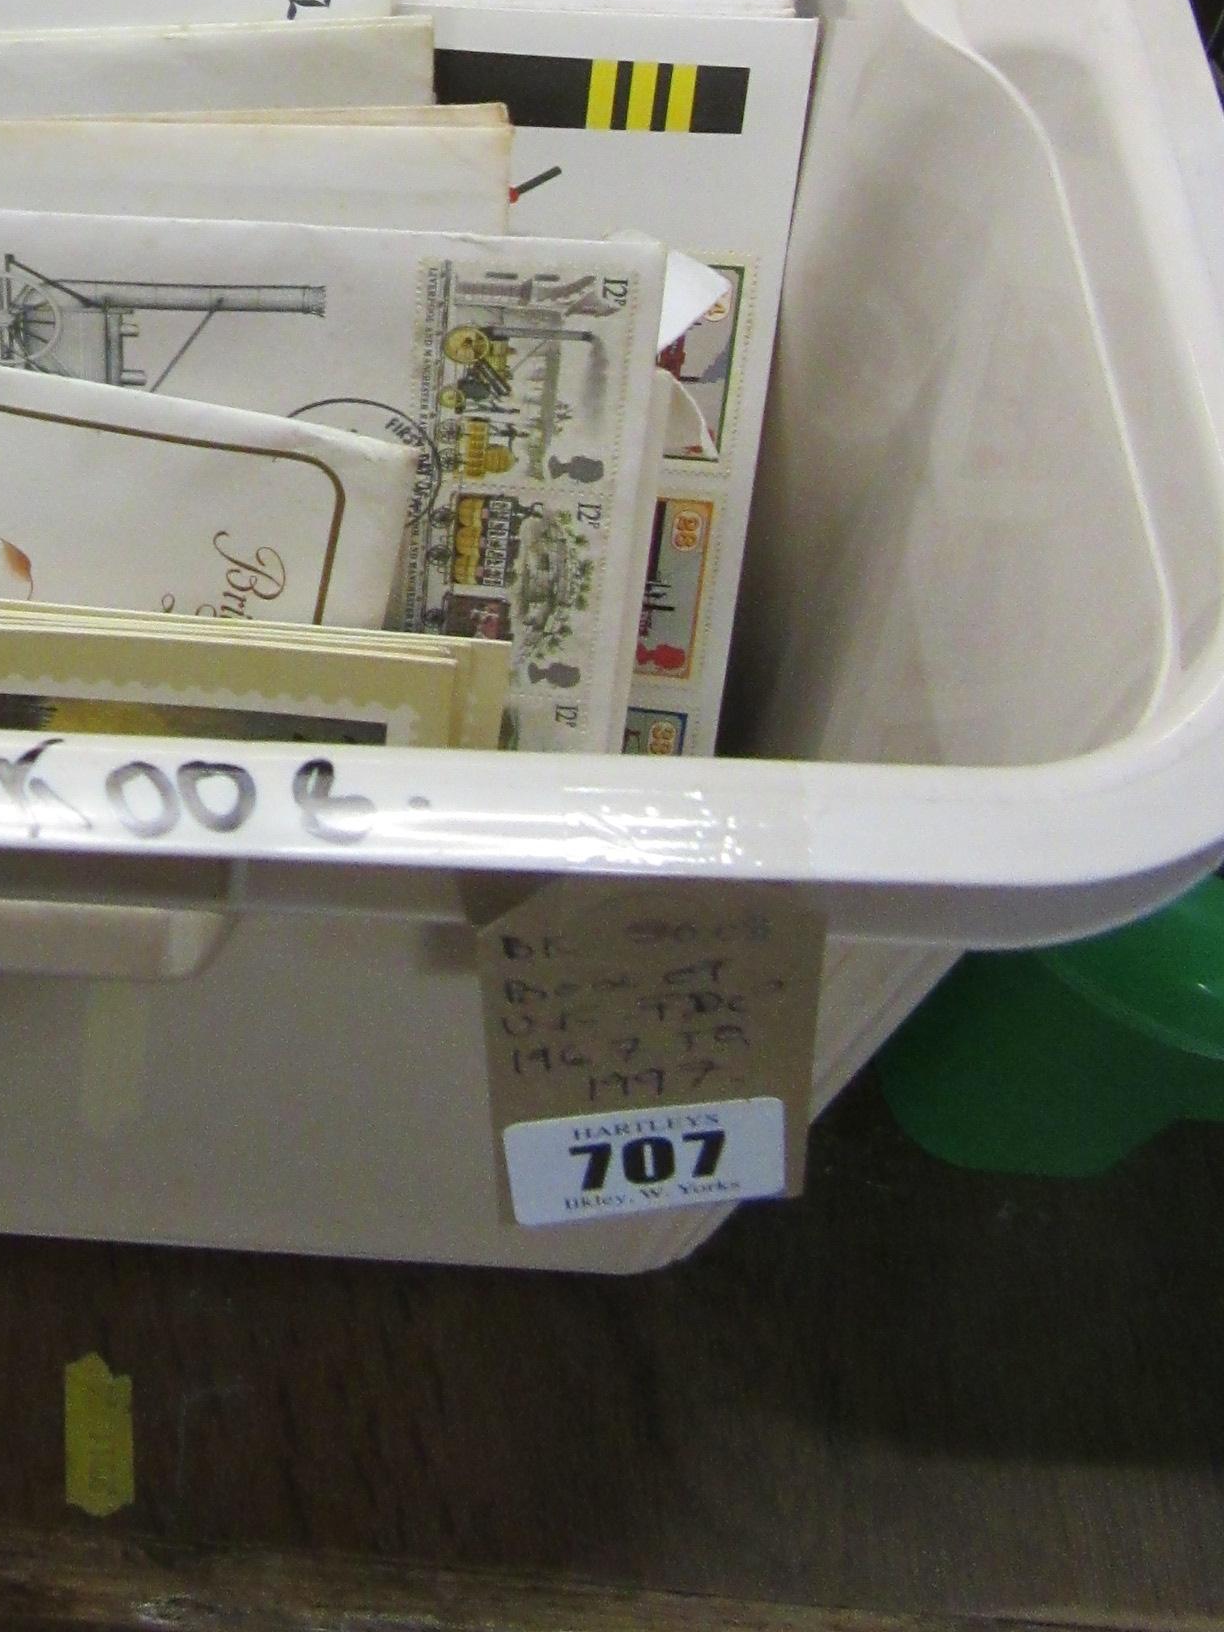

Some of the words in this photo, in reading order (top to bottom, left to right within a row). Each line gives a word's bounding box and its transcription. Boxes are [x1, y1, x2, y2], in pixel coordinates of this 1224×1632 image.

[572, 1112, 721, 1142] HARTLEYS
[568, 1129, 726, 1192] 707
[677, 1179, 741, 1197] Yorks
